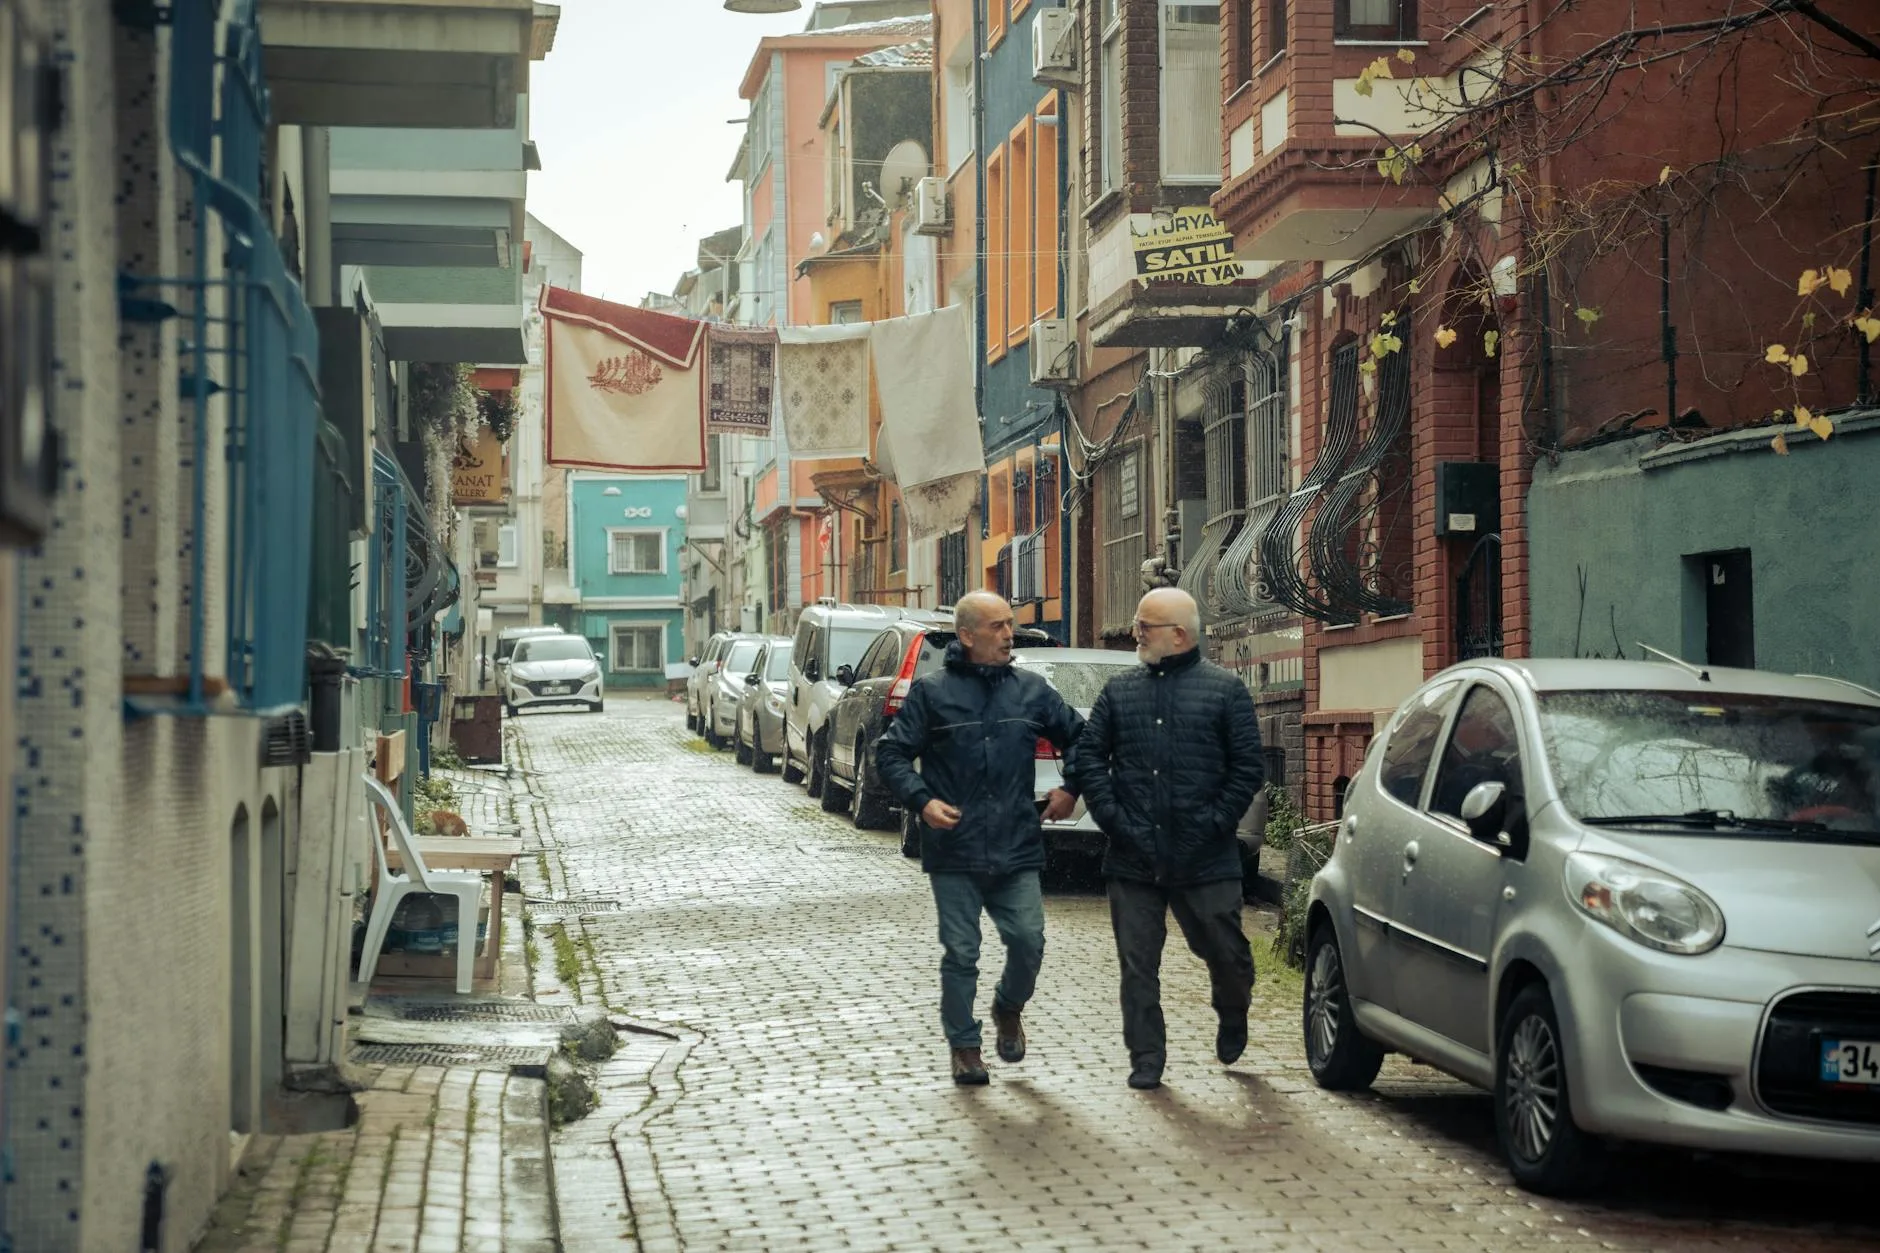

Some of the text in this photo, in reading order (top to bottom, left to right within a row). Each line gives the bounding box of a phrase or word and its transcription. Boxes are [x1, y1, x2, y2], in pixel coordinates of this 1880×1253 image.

[1153, 212, 1221, 236] URYA
[1145, 242, 1235, 270] SATIL
[453, 474, 494, 487] ANAT
[452, 488, 488, 498] ALLERY
